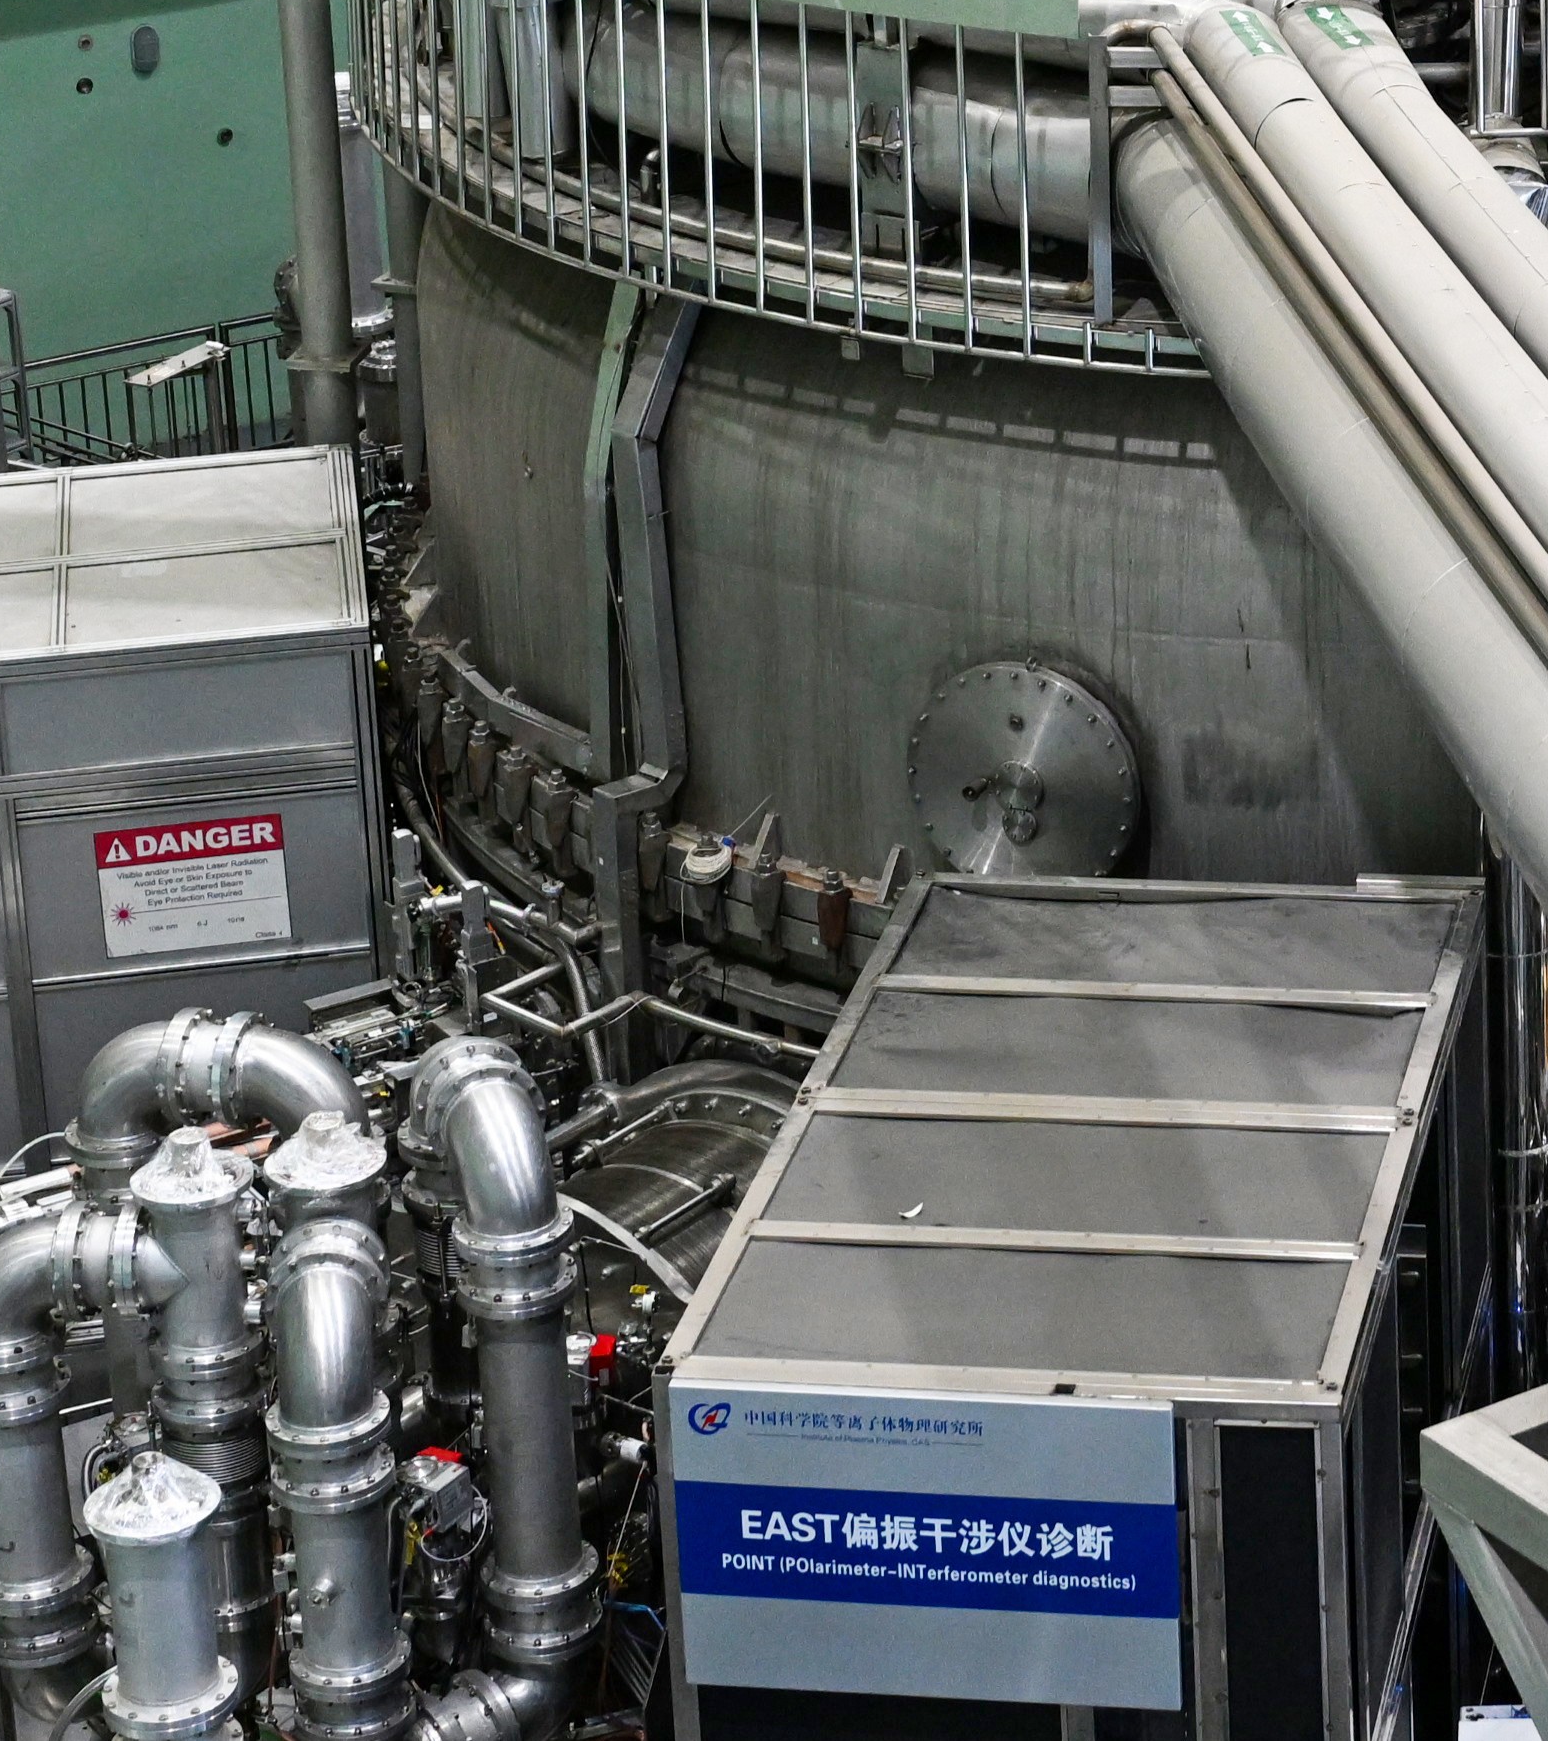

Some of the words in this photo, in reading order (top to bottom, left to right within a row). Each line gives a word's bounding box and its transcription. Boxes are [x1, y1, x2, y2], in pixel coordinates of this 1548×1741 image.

[135, 822, 276, 858] DANGER
[117, 871, 143, 880] Visible
[172, 864, 204, 874] Invisible
[206, 861, 229, 870] Laser
[231, 857, 268, 867] Radiation
[134, 880, 156, 888] Avoid
[158, 876, 174, 886] Eye
[186, 874, 203, 882] Skin
[205, 870, 243, 881] Exposure
[144, 888, 168, 897] Direct
[180, 882, 218, 892] Scattered
[221, 879, 243, 888] Beam
[147, 898, 163, 907] Eye
[207, 889, 243, 900] Required
[744, 1409, 984, 1438] 中国科学院等离子体物理研究所
[740, 1508, 1115, 1562] EAST偏振干涉仪诊断
[721, 1553, 775, 1574] POINT
[1032, 1568, 1138, 1594] diagnostics)
